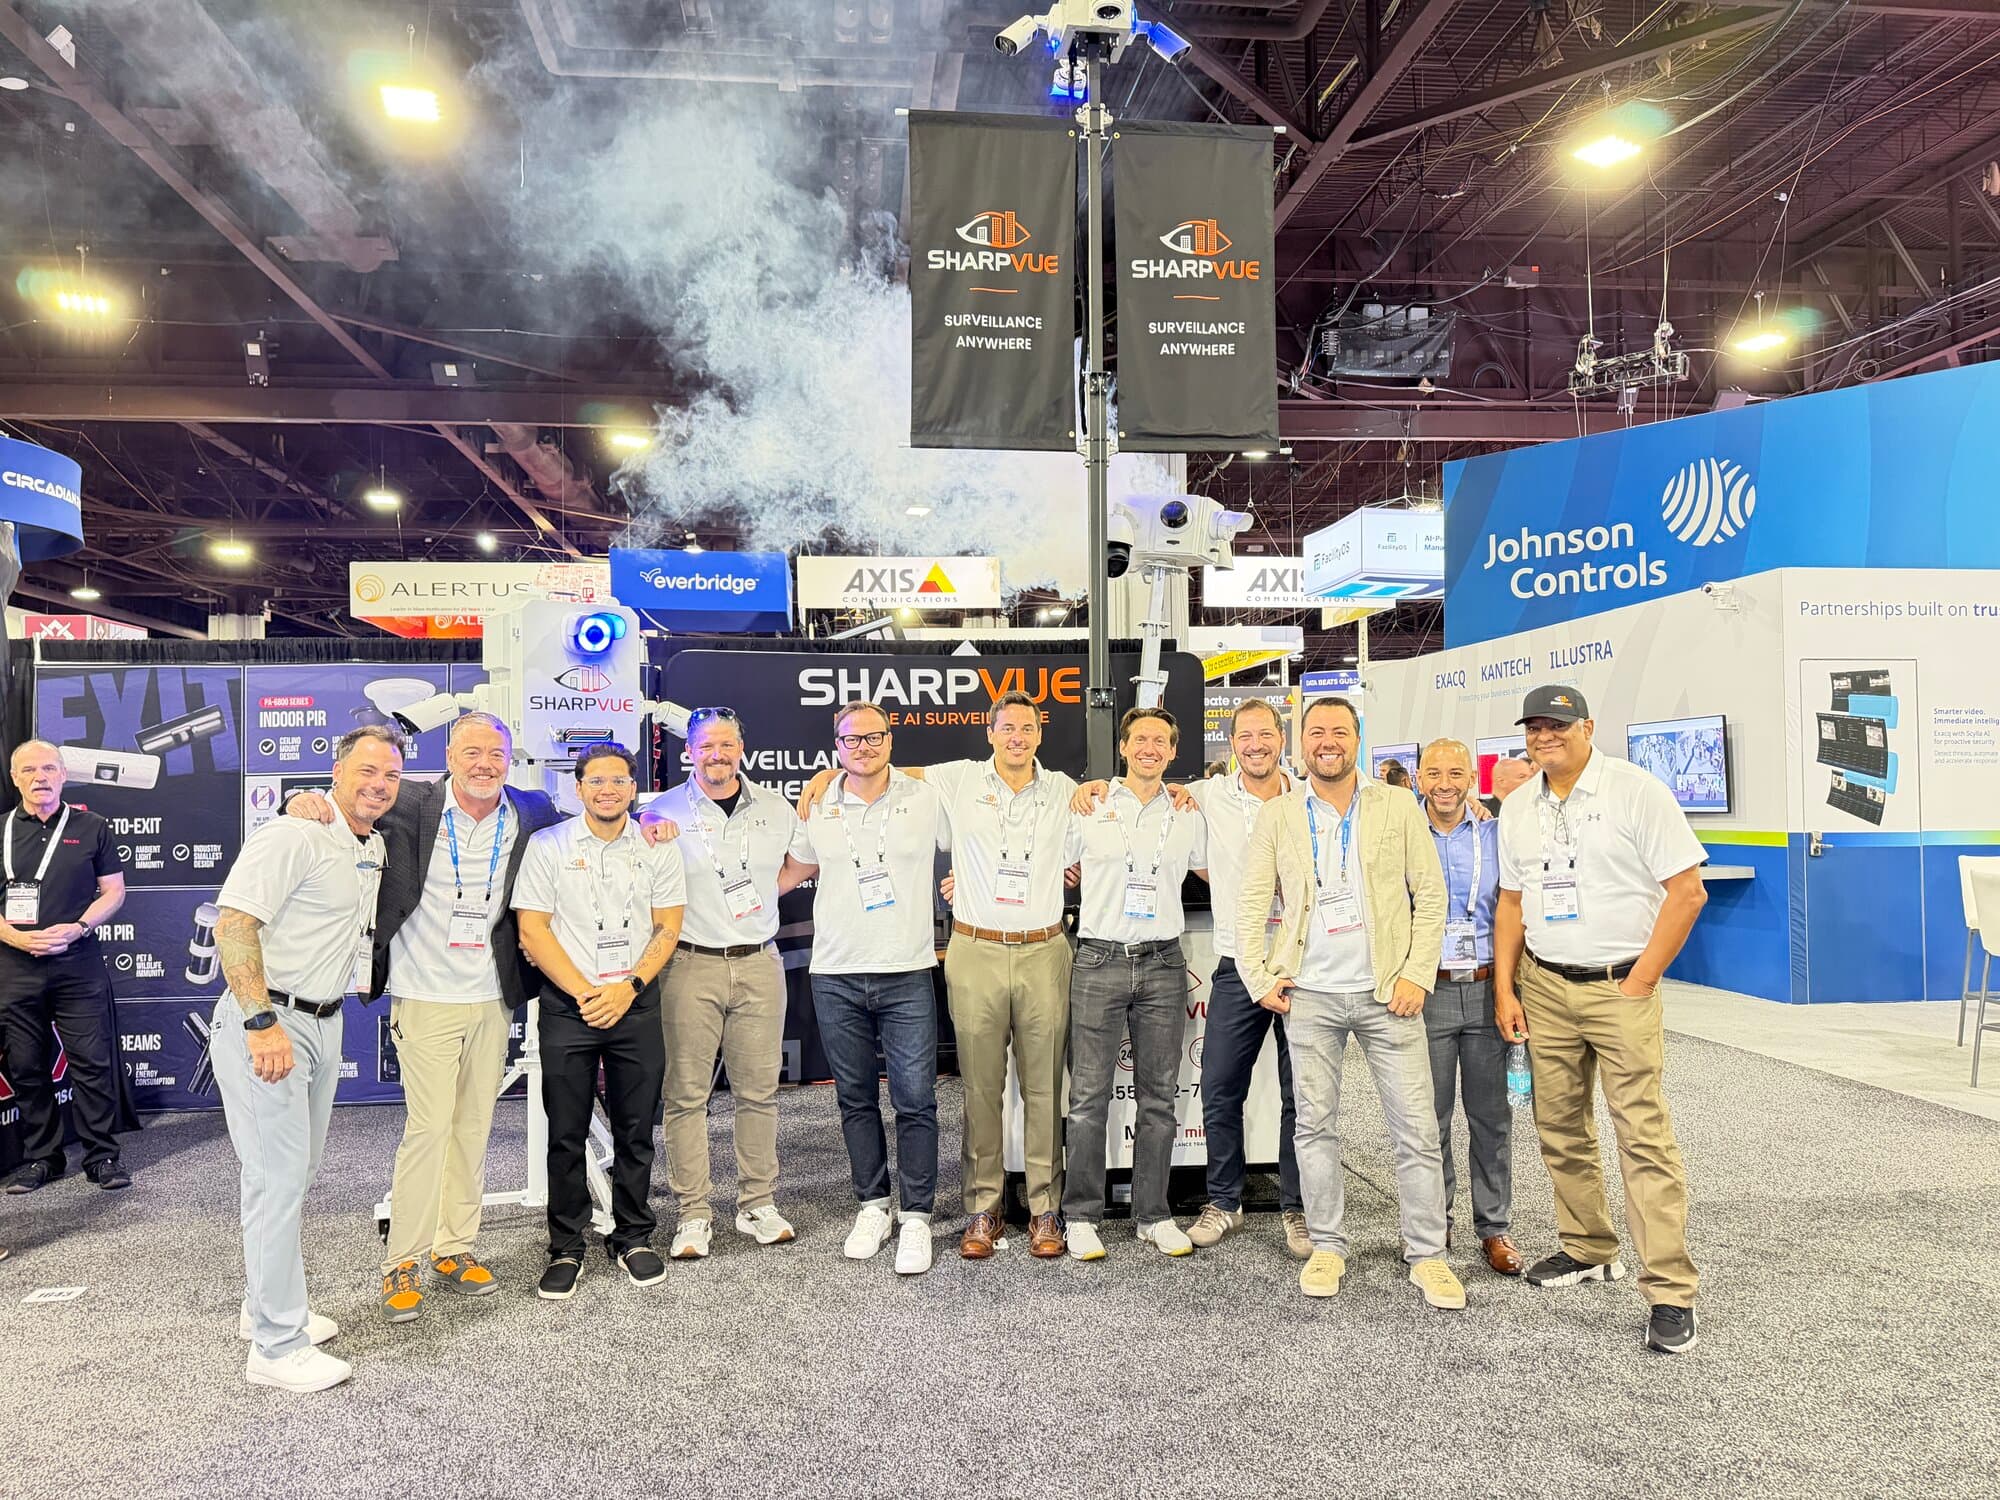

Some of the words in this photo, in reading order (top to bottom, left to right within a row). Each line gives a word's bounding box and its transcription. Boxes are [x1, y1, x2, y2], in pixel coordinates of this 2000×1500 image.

[927, 249, 1059, 274] SHARPVUE
[1131, 259, 1260, 280] SHARPVUE
[944, 314, 1042, 330] SURVEILLANCE
[1148, 322, 1245, 335] SURVEILLANCE
[956, 336, 1032, 350] ANYWHERE
[1160, 343, 1236, 356] ANYWHERE
[1483, 522, 1633, 570] Johnson
[653, 568, 755, 595] everbridge
[843, 568, 914, 593] AXIS
[1246, 568, 1304, 592] AXI
[1510, 552, 1668, 598] Controls
[1800, 601, 1903, 620] Partnerships
[1908, 602, 1943, 617] built
[1948, 605, 1968, 617] on
[1435, 670, 1466, 690] EXACQ
[1481, 656, 1532, 682] KANTECH
[1550, 639, 1613, 670] ILLUSTRA
[798, 667, 1081, 706] SHARPVUE
[529, 696, 634, 713] SHARPVUE
[37, 667, 242, 788] EXIT
[259, 711, 305, 728] INDOOR
[307, 710, 327, 727] PIR
[904, 713, 921, 726] AI
[925, 712, 1050, 726] SURVEILE
[1934, 717, 1973, 725] Immediate
[106, 817, 162, 835] -TO-EXIT
[114, 925, 135, 941] PIR
